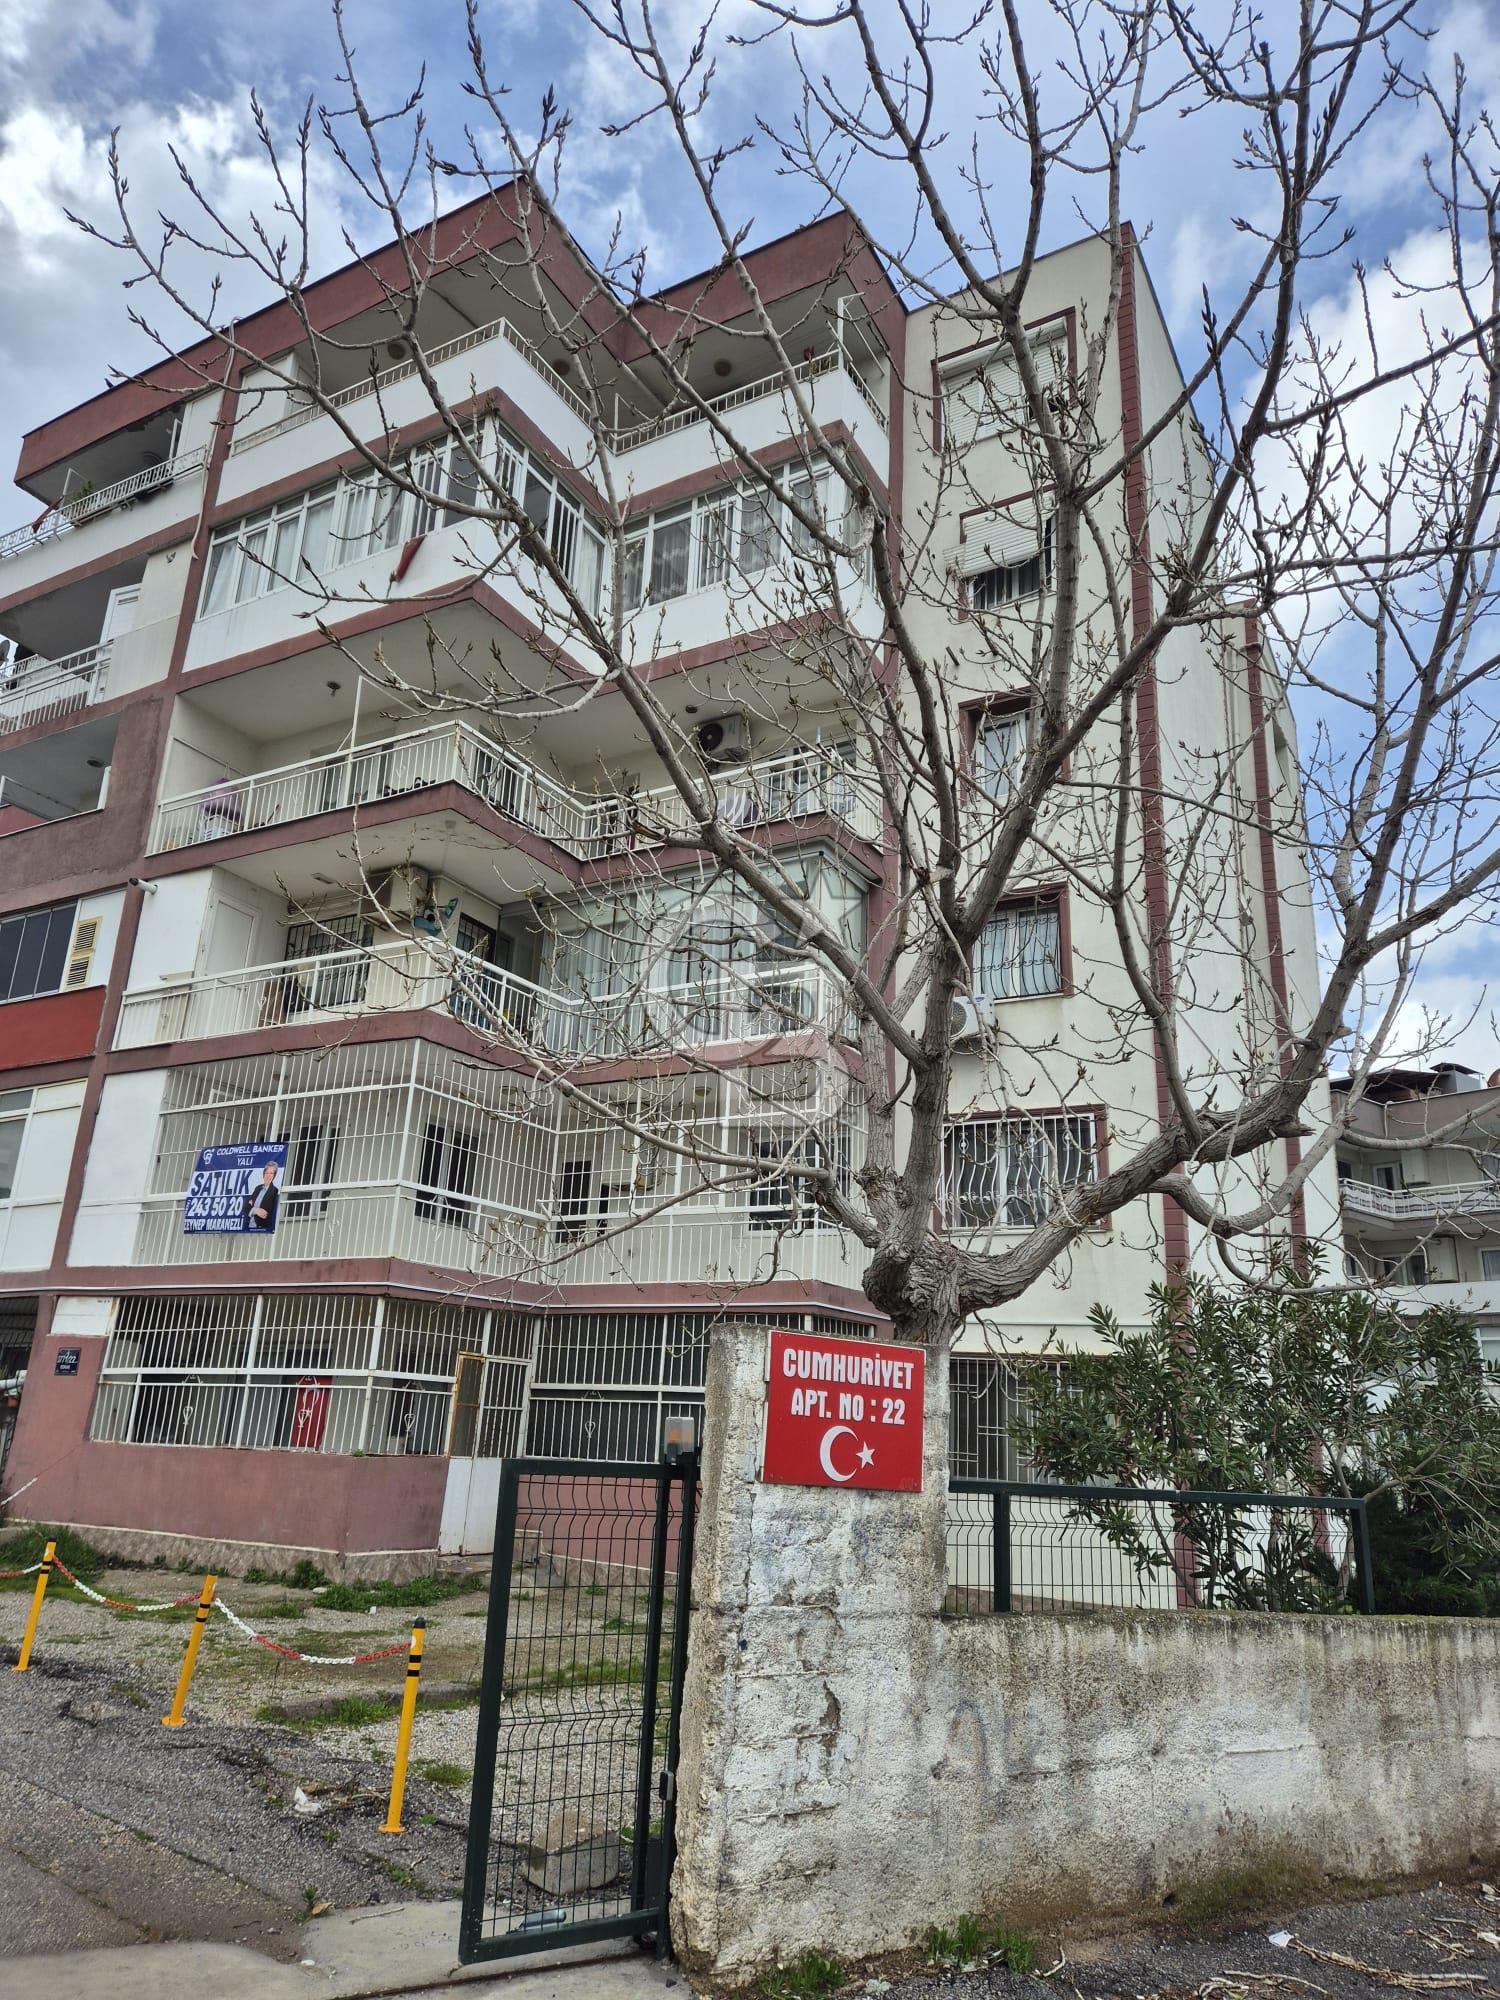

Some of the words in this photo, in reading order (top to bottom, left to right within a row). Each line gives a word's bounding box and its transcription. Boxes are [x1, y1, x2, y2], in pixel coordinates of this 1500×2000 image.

[216, 1146, 250, 1156] COLDWELL
[252, 1145, 284, 1153] BANKER
[191, 1170, 254, 1196] SATILIK
[188, 1197, 211, 1216] 243
[211, 1197, 227, 1216] 50
[227, 1196, 243, 1216] 20
[783, 1348, 914, 1390] CUMHURİYET
[791, 1388, 832, 1419] APT.
[839, 1392, 864, 1422] NO
[882, 1398, 906, 1425] 22
